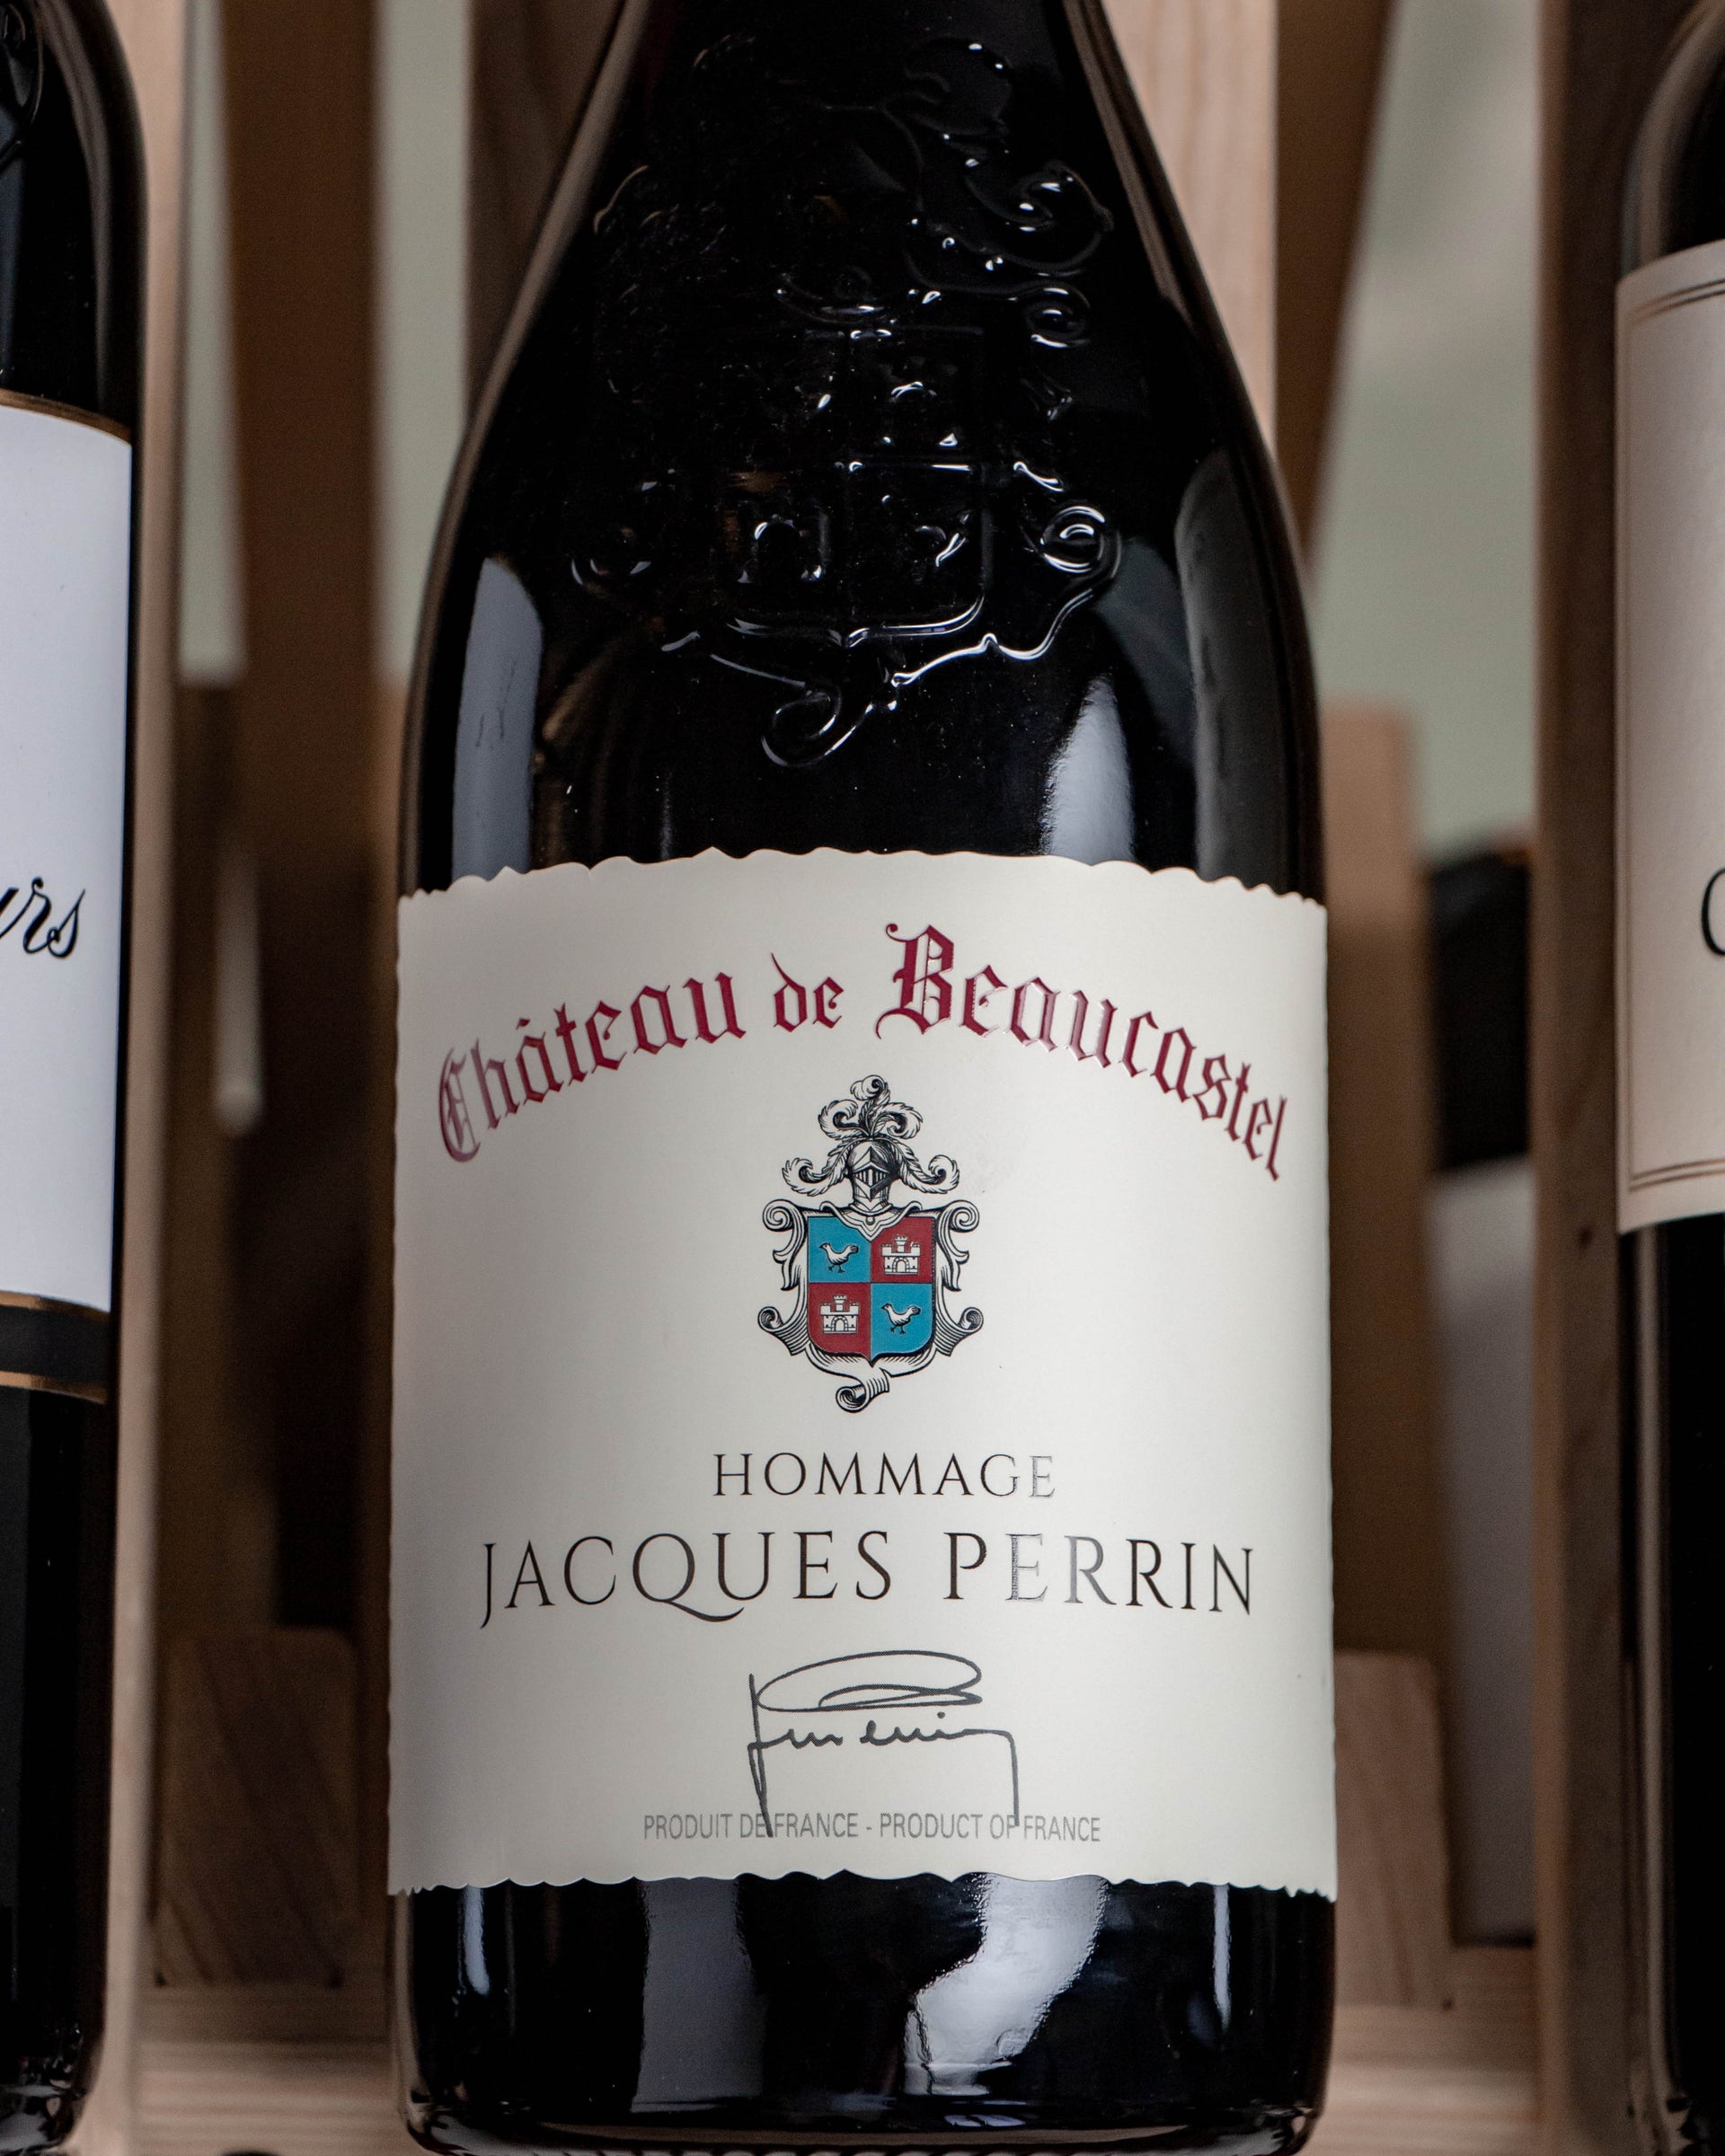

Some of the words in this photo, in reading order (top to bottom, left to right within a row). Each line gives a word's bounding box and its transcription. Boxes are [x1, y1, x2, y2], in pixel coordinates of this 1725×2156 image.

[770, 951, 845, 1033] de
[874, 923, 1288, 1182] Beaucastel
[712, 1451, 1056, 1498] HOMMAGE
[479, 1530, 892, 1630] JACQUES
[942, 1531, 1254, 1615] PERRIN
[643, 1813, 734, 1840] PRODUIT
[739, 1813, 767, 1839] DE
[774, 1812, 860, 1839] FRANCE
[880, 1812, 984, 1840] PRODUCT
[989, 1813, 1018, 1841] OF
[1023, 1815, 1101, 1842] FRANCE
